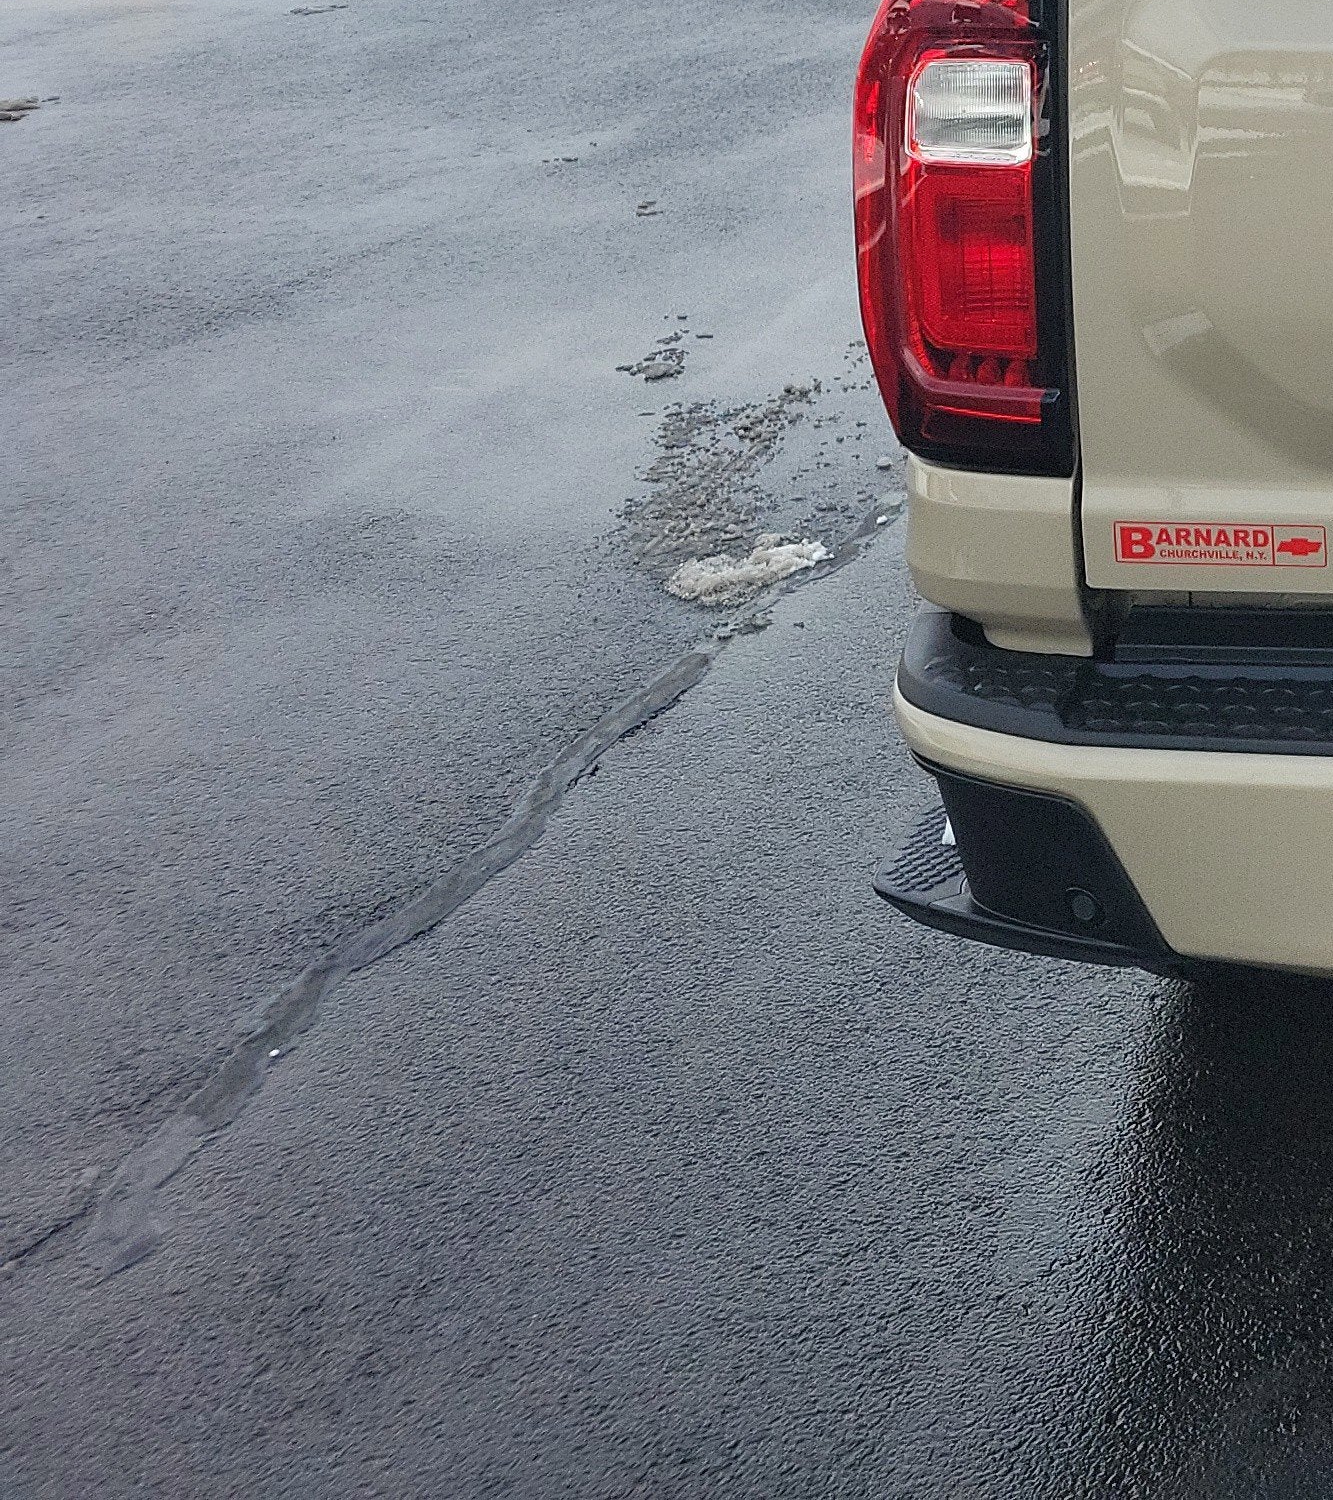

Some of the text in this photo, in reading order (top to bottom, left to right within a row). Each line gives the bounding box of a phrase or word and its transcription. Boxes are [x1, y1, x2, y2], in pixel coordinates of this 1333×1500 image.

[1119, 525, 1270, 560] BARNARD
[1159, 548, 1268, 562] CHURCHVILLE, N.Y.
